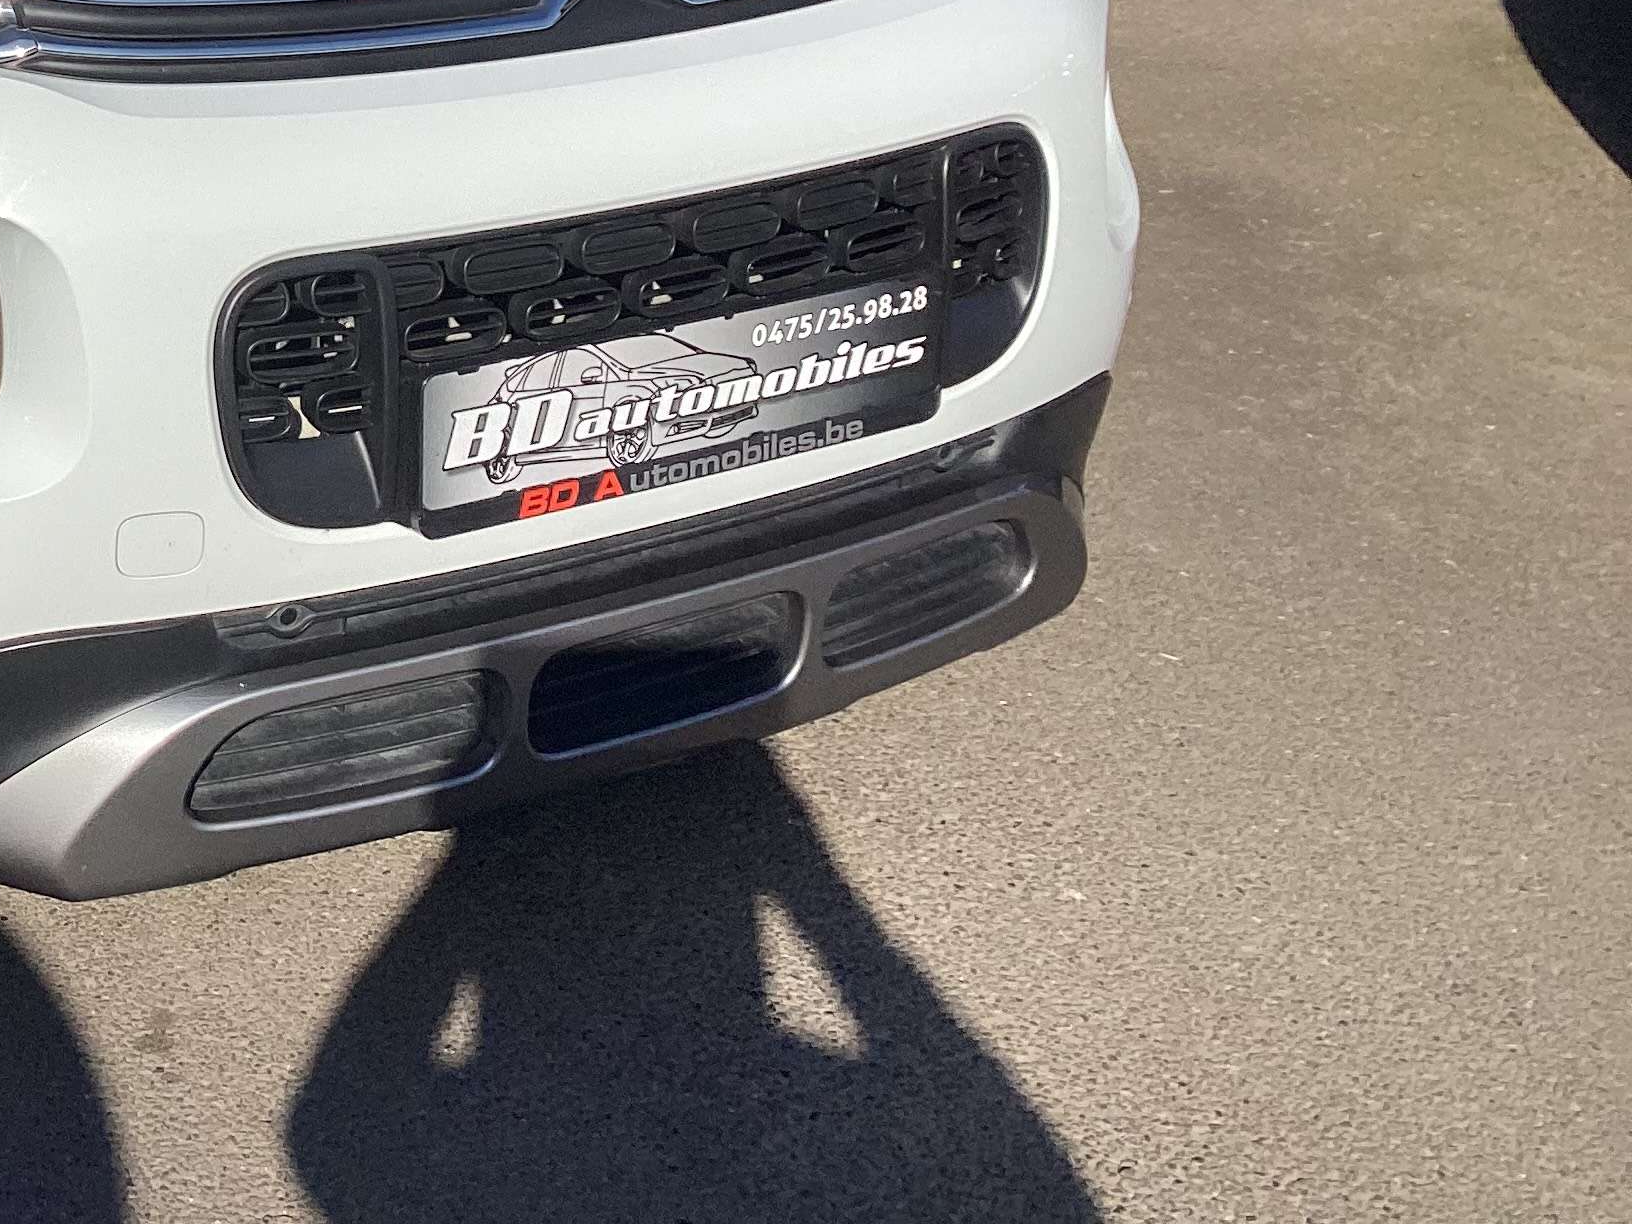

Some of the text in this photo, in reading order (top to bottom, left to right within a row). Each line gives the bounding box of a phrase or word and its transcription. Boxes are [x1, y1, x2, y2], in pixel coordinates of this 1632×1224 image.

[751, 285, 928, 348] 0475/25.98.28
[442, 334, 928, 473] BD automobiles
[518, 479, 581, 519] BD
